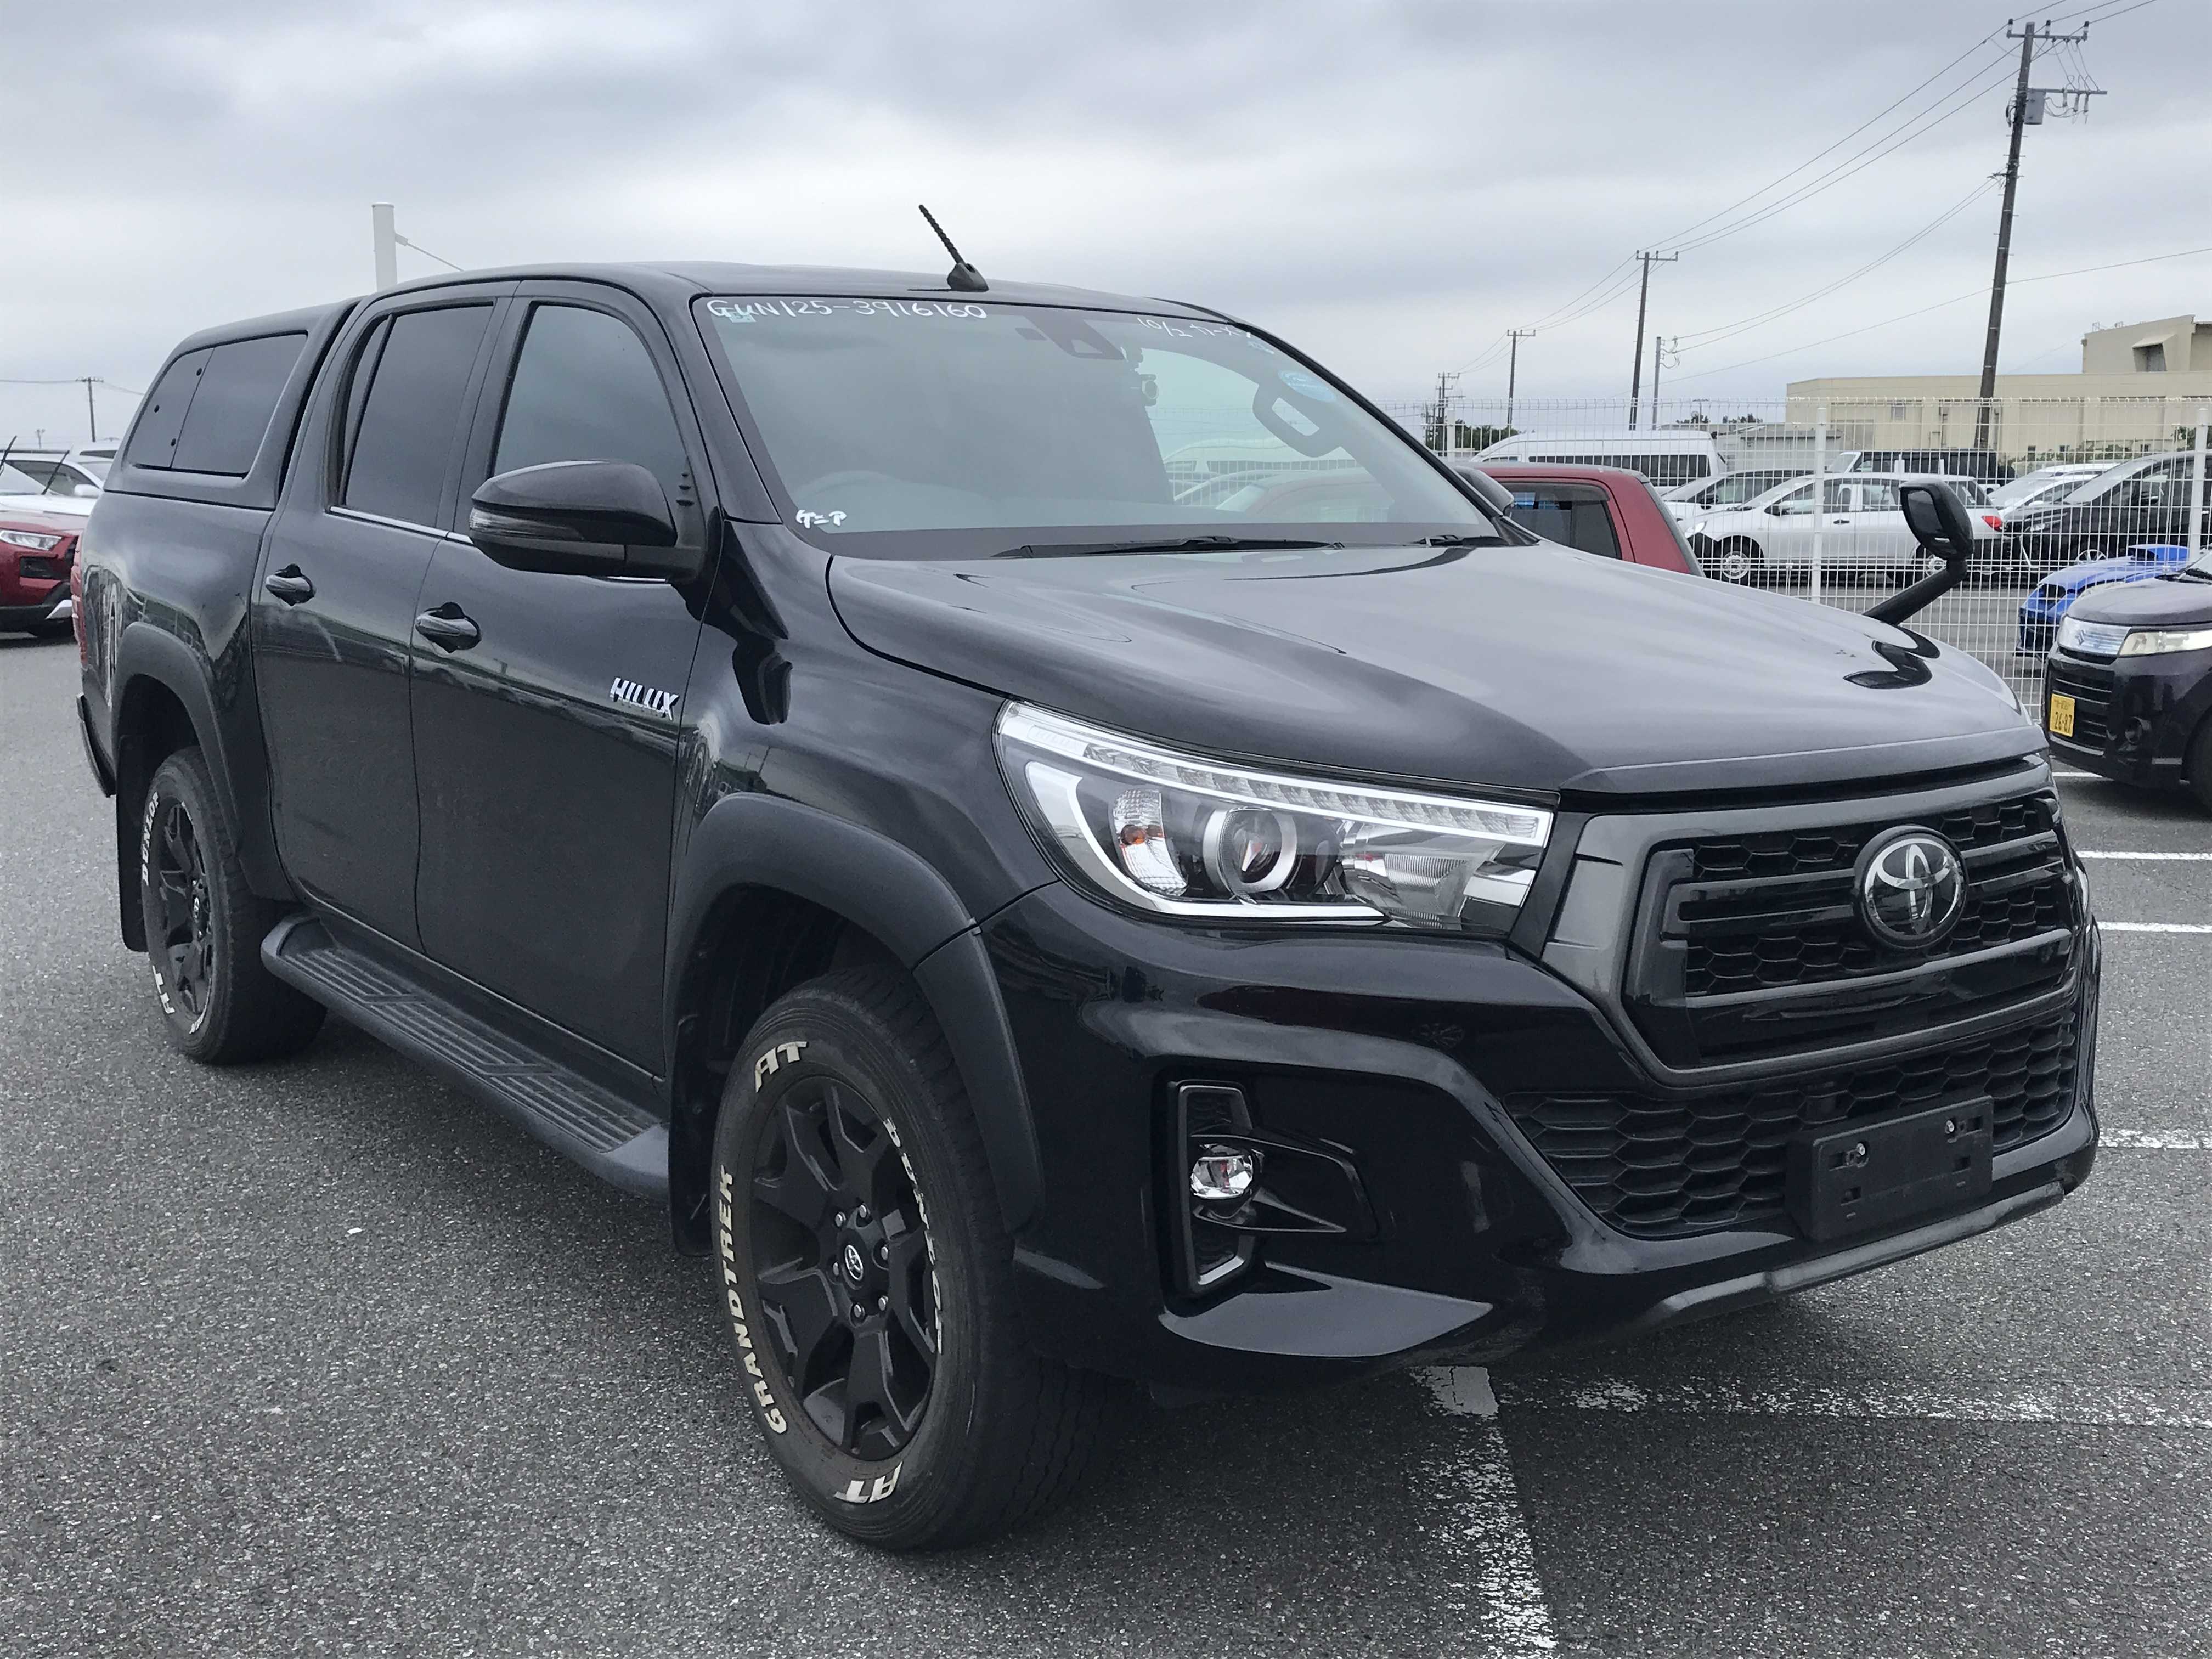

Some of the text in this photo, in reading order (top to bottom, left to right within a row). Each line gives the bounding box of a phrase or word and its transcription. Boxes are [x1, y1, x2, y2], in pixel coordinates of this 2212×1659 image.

[610, 677, 679, 720] HILUX
[755, 1041, 807, 1093] AT
[719, 1165, 787, 1434] GRANDTREK
[834, 1462, 902, 1503] AT
